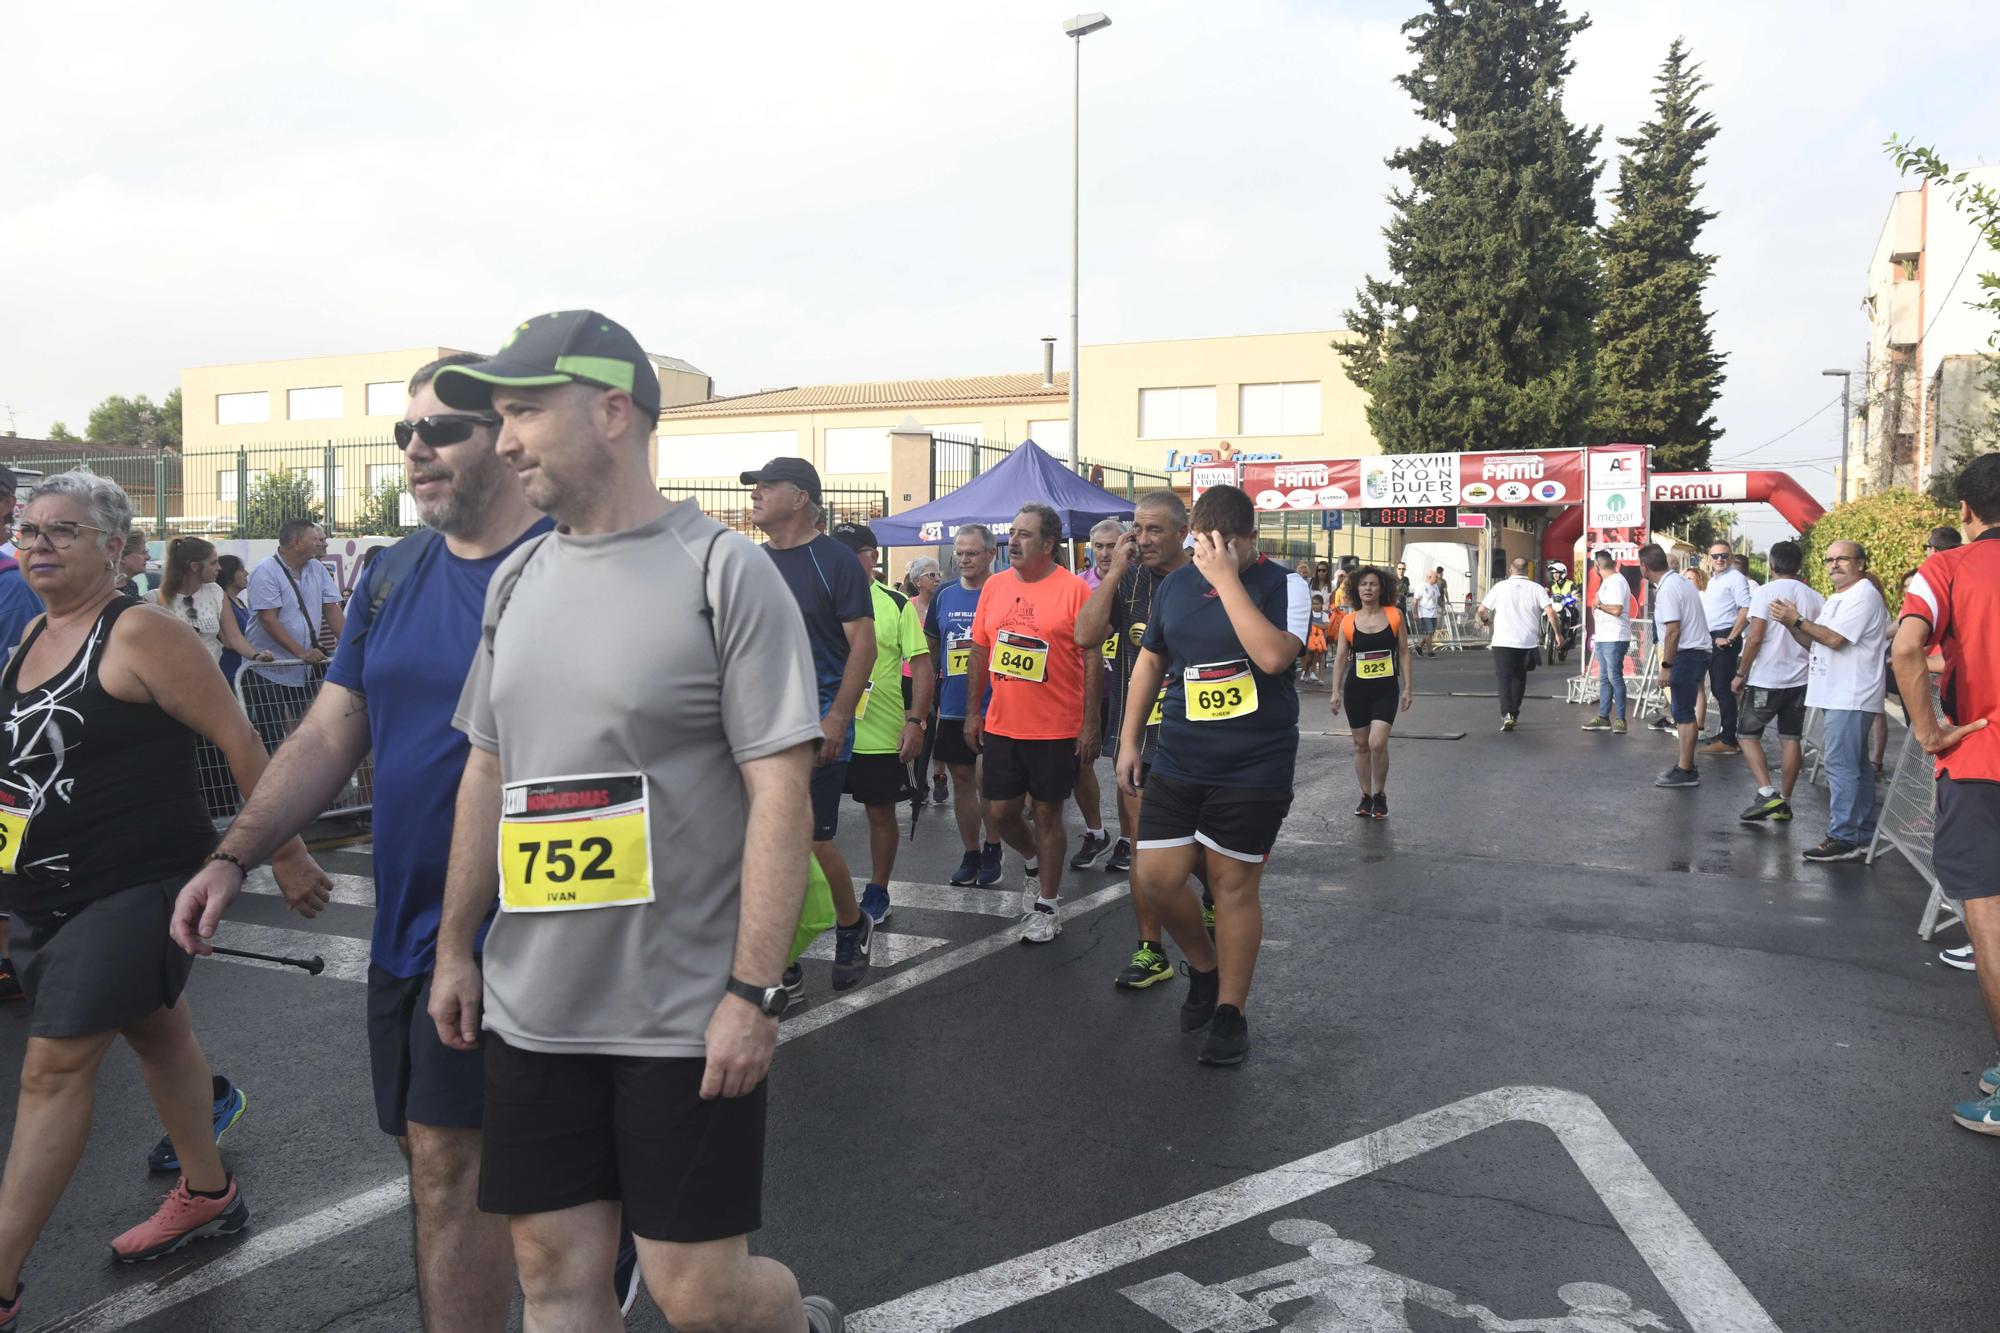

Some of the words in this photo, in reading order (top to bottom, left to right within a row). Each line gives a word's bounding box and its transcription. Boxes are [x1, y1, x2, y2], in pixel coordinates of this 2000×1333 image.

[1392, 456, 1451, 470] XXVIII
[1610, 457, 1631, 471] AC
[1392, 469, 1451, 481] NON
[1482, 463, 1544, 480] FAMU
[1274, 471, 1328, 487] FAMU
[1393, 480, 1452, 493] DUER
[1656, 484, 1722, 499] FAMU
[1392, 492, 1452, 504] MAS
[1381, 508, 1446, 524] 0:01:28
[1597, 513, 1633, 524] megar
[954, 655, 969, 668] 77
[1001, 652, 1034, 671] 840
[1363, 662, 1386, 674] 823
[1198, 687, 1242, 710] 693
[518, 836, 615, 885] 752
[547, 892, 576, 901] IVAN
